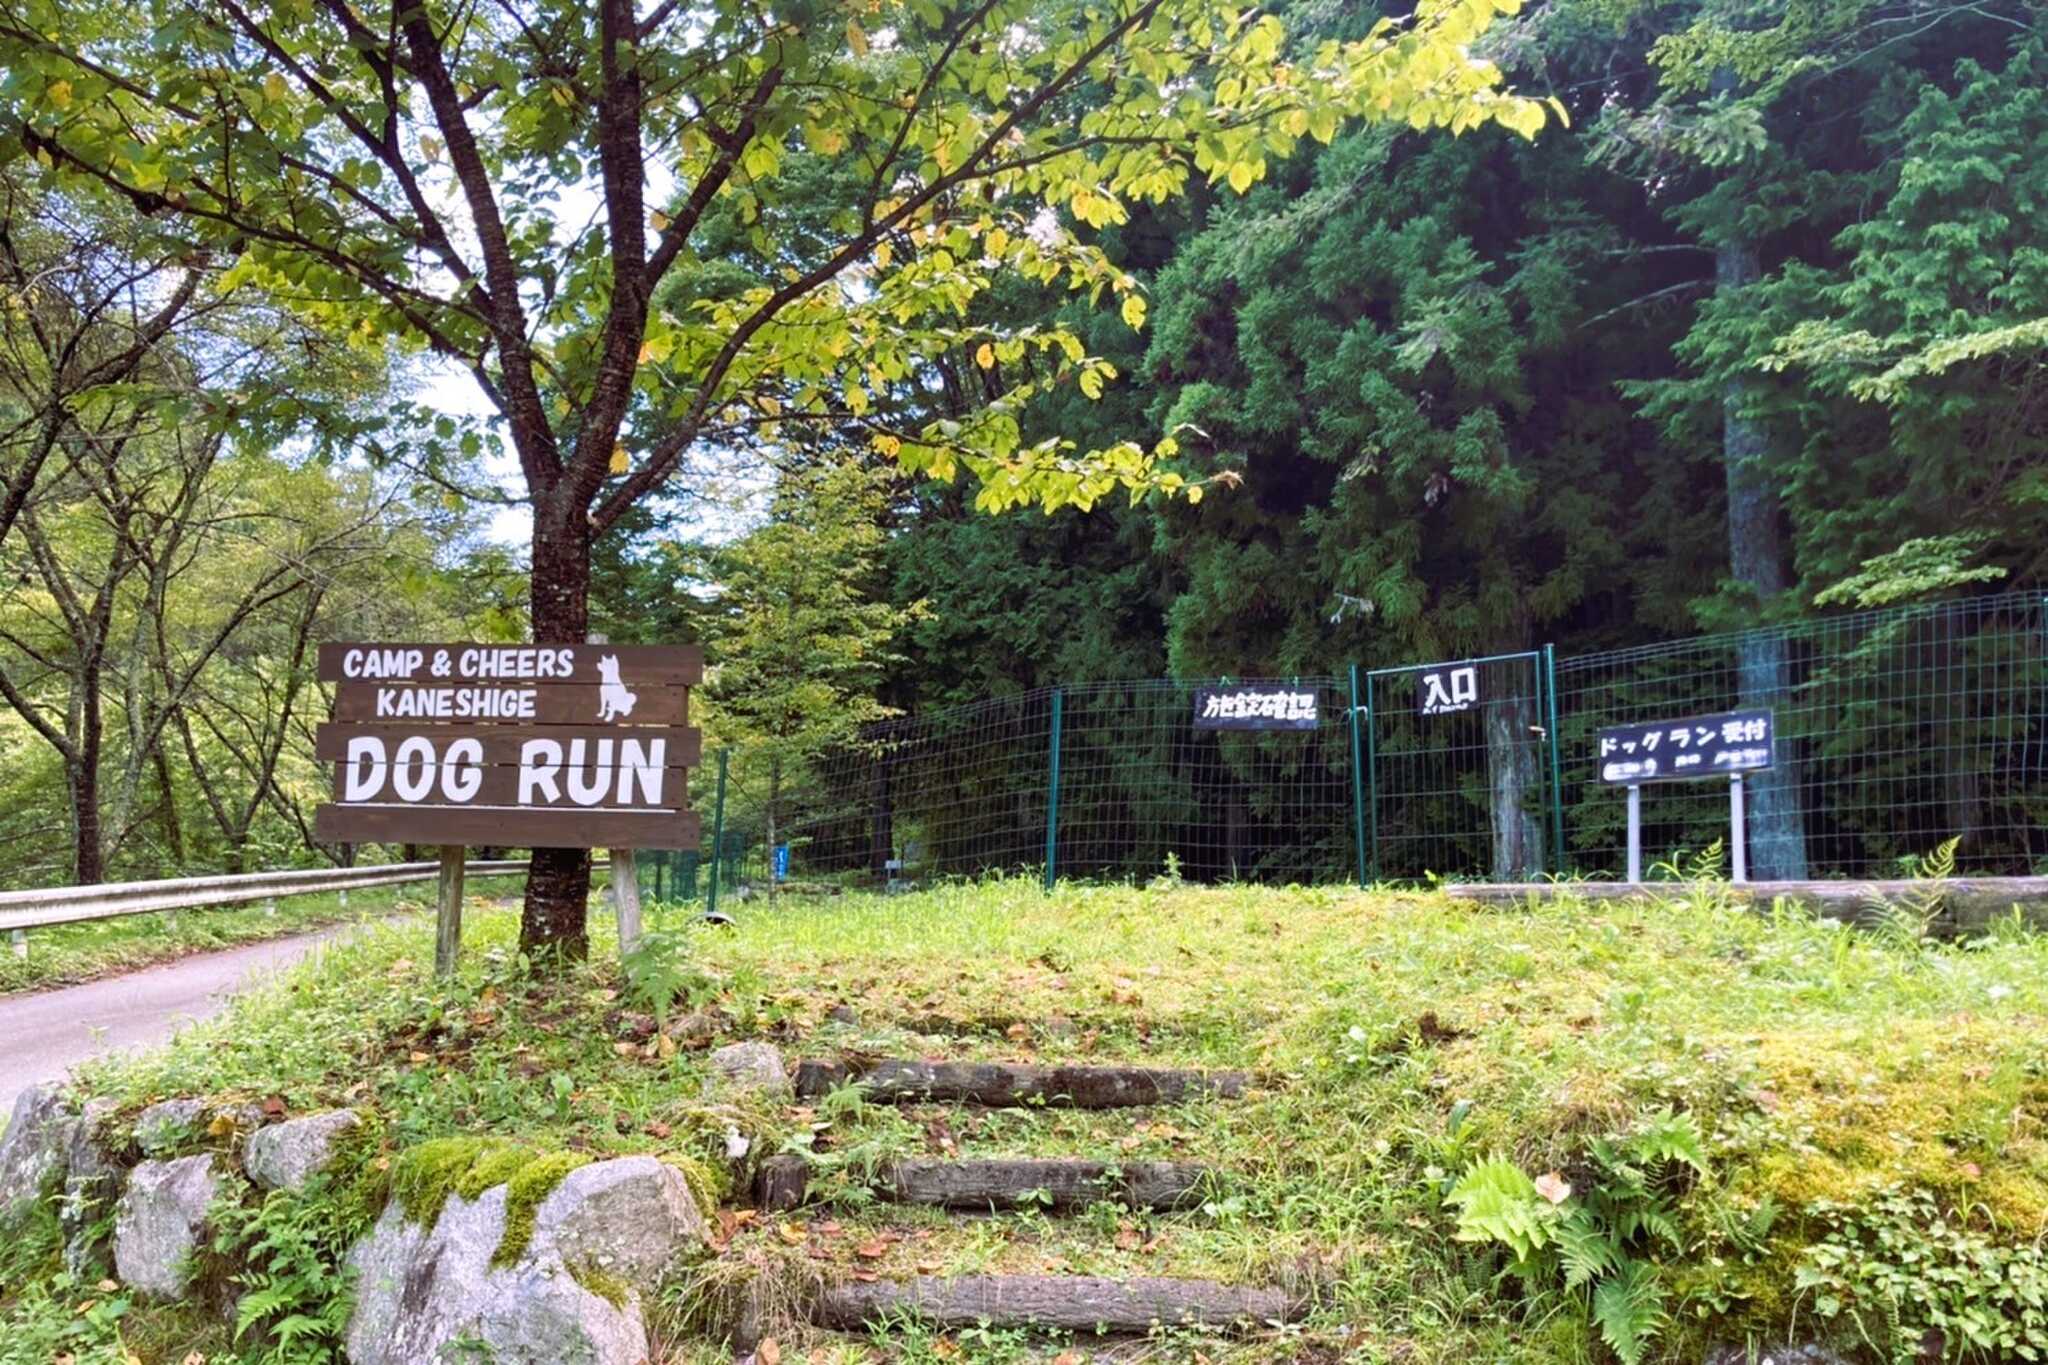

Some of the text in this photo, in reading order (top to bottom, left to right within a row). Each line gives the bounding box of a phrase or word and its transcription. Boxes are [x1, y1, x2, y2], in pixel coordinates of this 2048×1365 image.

[343, 648, 575, 678] CAMP & CHEERS
[376, 688, 537, 718] KANESHIGE
[1423, 667, 1477, 707] 入口
[344, 735, 666, 806] DOG RUN
